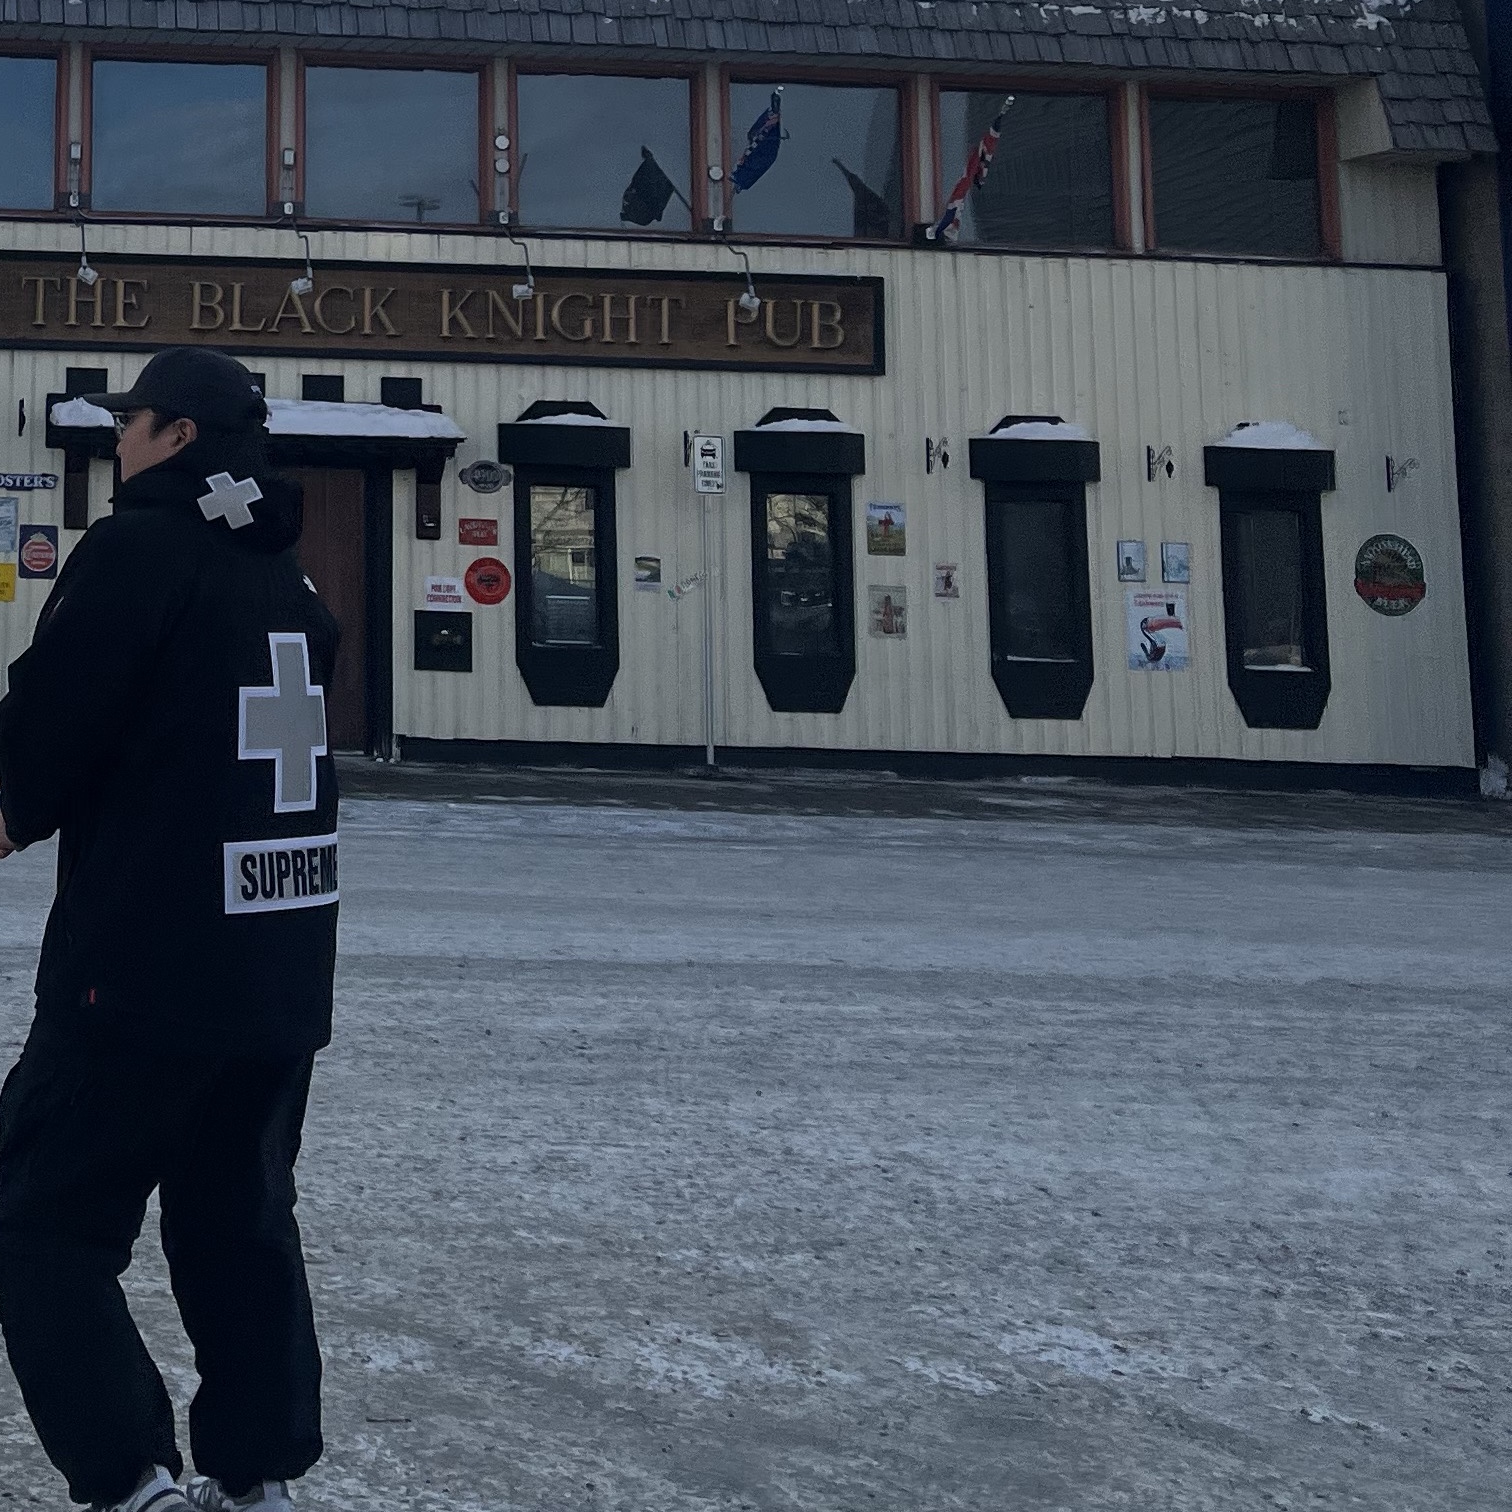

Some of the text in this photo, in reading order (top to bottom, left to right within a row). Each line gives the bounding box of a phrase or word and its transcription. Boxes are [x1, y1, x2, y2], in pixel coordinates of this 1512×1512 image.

[21, 275, 846, 350] THE BLACK KNIGHT PUB
[240, 843, 338, 901] SUPREME
